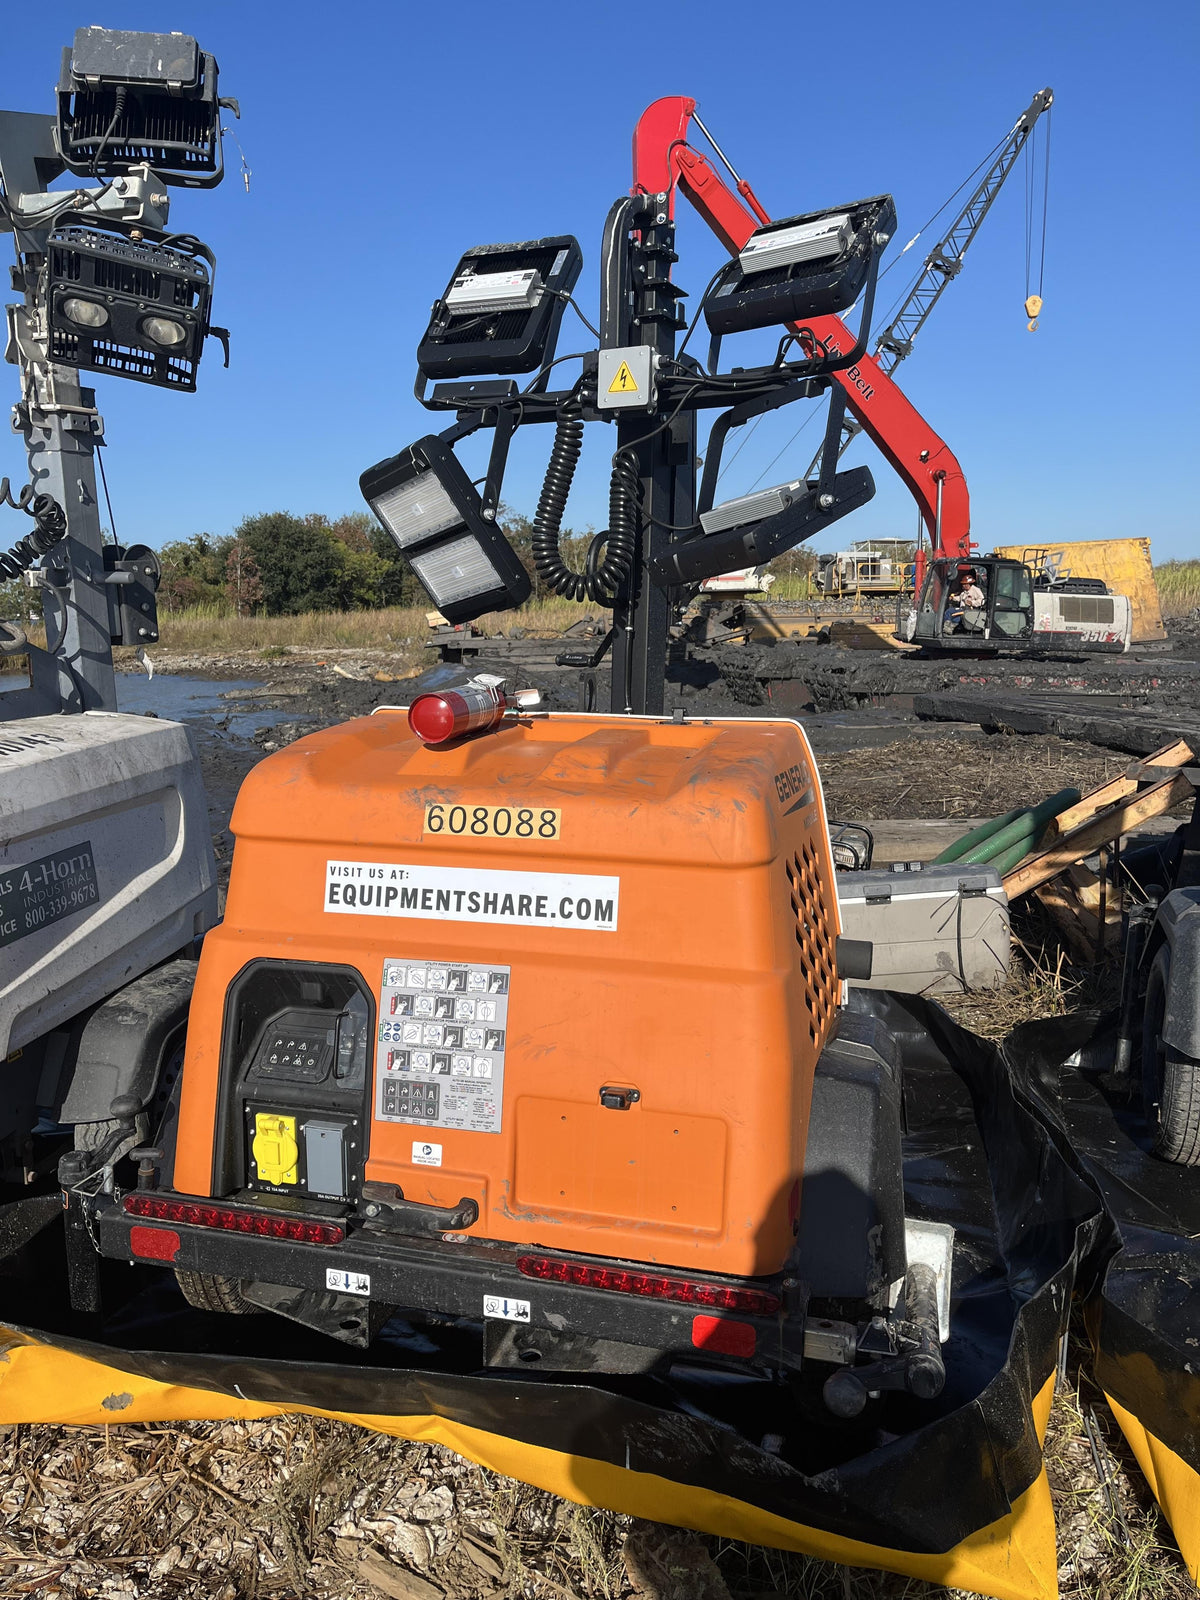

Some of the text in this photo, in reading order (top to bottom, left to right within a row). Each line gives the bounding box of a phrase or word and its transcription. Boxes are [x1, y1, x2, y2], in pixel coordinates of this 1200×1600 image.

[427, 804, 557, 838] 608088
[19, 853, 91, 893] 4-Horn
[23, 871, 92, 908] INDUSTRIAL
[330, 866, 409, 880] VISIT US AT:
[25, 883, 96, 929] 800-339-9678
[328, 882, 614, 923] EQUIPMENTSHARE.COM
